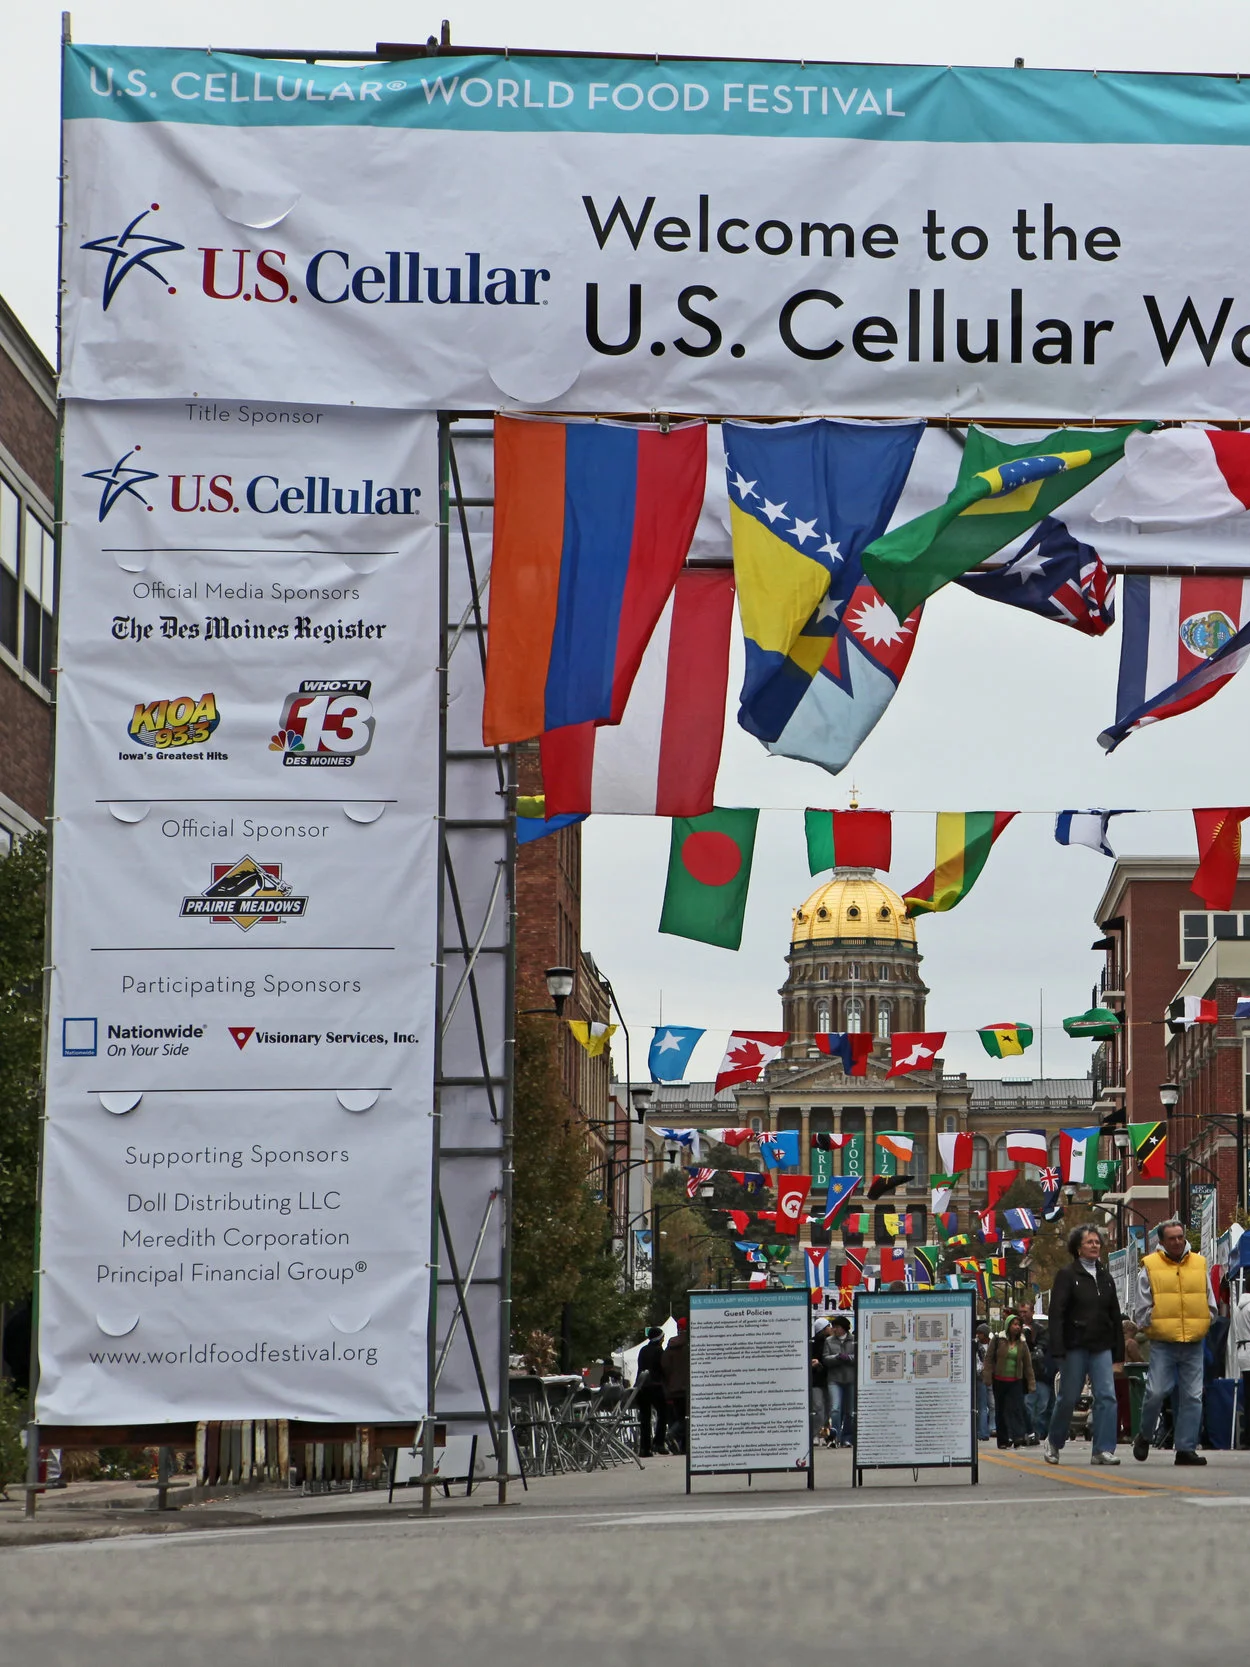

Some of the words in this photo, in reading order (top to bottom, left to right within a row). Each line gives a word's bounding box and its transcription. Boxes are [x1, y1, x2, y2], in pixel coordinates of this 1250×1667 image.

[90, 68, 157, 98] U.S.
[422, 76, 574, 110] WORLD
[588, 81, 709, 112] FOOD
[723, 82, 905, 118] FESTIVAL
[582, 193, 899, 258] Welcome
[923, 209, 989, 262] to
[1012, 202, 1122, 262] the
[199, 246, 298, 305] U.S.
[585, 283, 746, 358] U.S.
[778, 288, 1114, 366] Cellular
[185, 403, 230, 423] Title
[238, 405, 324, 426] Sponsor
[168, 474, 239, 514] U.S.
[133, 582, 198, 600] Official
[206, 583, 264, 600] Media
[272, 583, 360, 603] Sponsors
[112, 616, 153, 643] The
[159, 615, 200, 640] Des
[205, 616, 289, 643] Moines
[295, 616, 387, 644] Register
[129, 692, 218, 735] KIOA
[297, 695, 374, 753] 13
[154, 727, 212, 749] 93.3
[118, 751, 153, 761] Iowa's
[156, 751, 204, 761] Greatest
[206, 751, 229, 761] Hits
[285, 757, 308, 766] DES
[310, 756, 352, 766] MOINES
[161, 820, 235, 838] Official
[242, 820, 330, 841] Sponsor
[186, 900, 236, 913] PRAIRIE
[239, 900, 302, 913] MEADOWS
[122, 975, 256, 997] Participating
[263, 975, 362, 995] Sponsors
[107, 1044, 126, 1056] On
[130, 1044, 159, 1057] Your
[162, 1043, 190, 1057] Side
[256, 1031, 321, 1046] Visionary
[326, 1031, 388, 1045] Services,
[393, 1031, 419, 1045] Inc.
[126, 1145, 244, 1168] Supporting
[251, 1144, 350, 1167] Sponsors
[817, 1148, 827, 1184] ORLD
[127, 1193, 166, 1213] Doll
[174, 1192, 291, 1215] Distributing
[299, 1191, 342, 1211] LLC
[122, 1228, 216, 1248] Meredith
[223, 1228, 350, 1251] Corporation
[97, 1264, 184, 1287] Principal
[191, 1263, 280, 1283] Financial
[724, 1309, 745, 1317] Guest
[746, 1308, 773, 1316] Policies
[89, 1342, 379, 1366] www.worldfoodfestival.org
